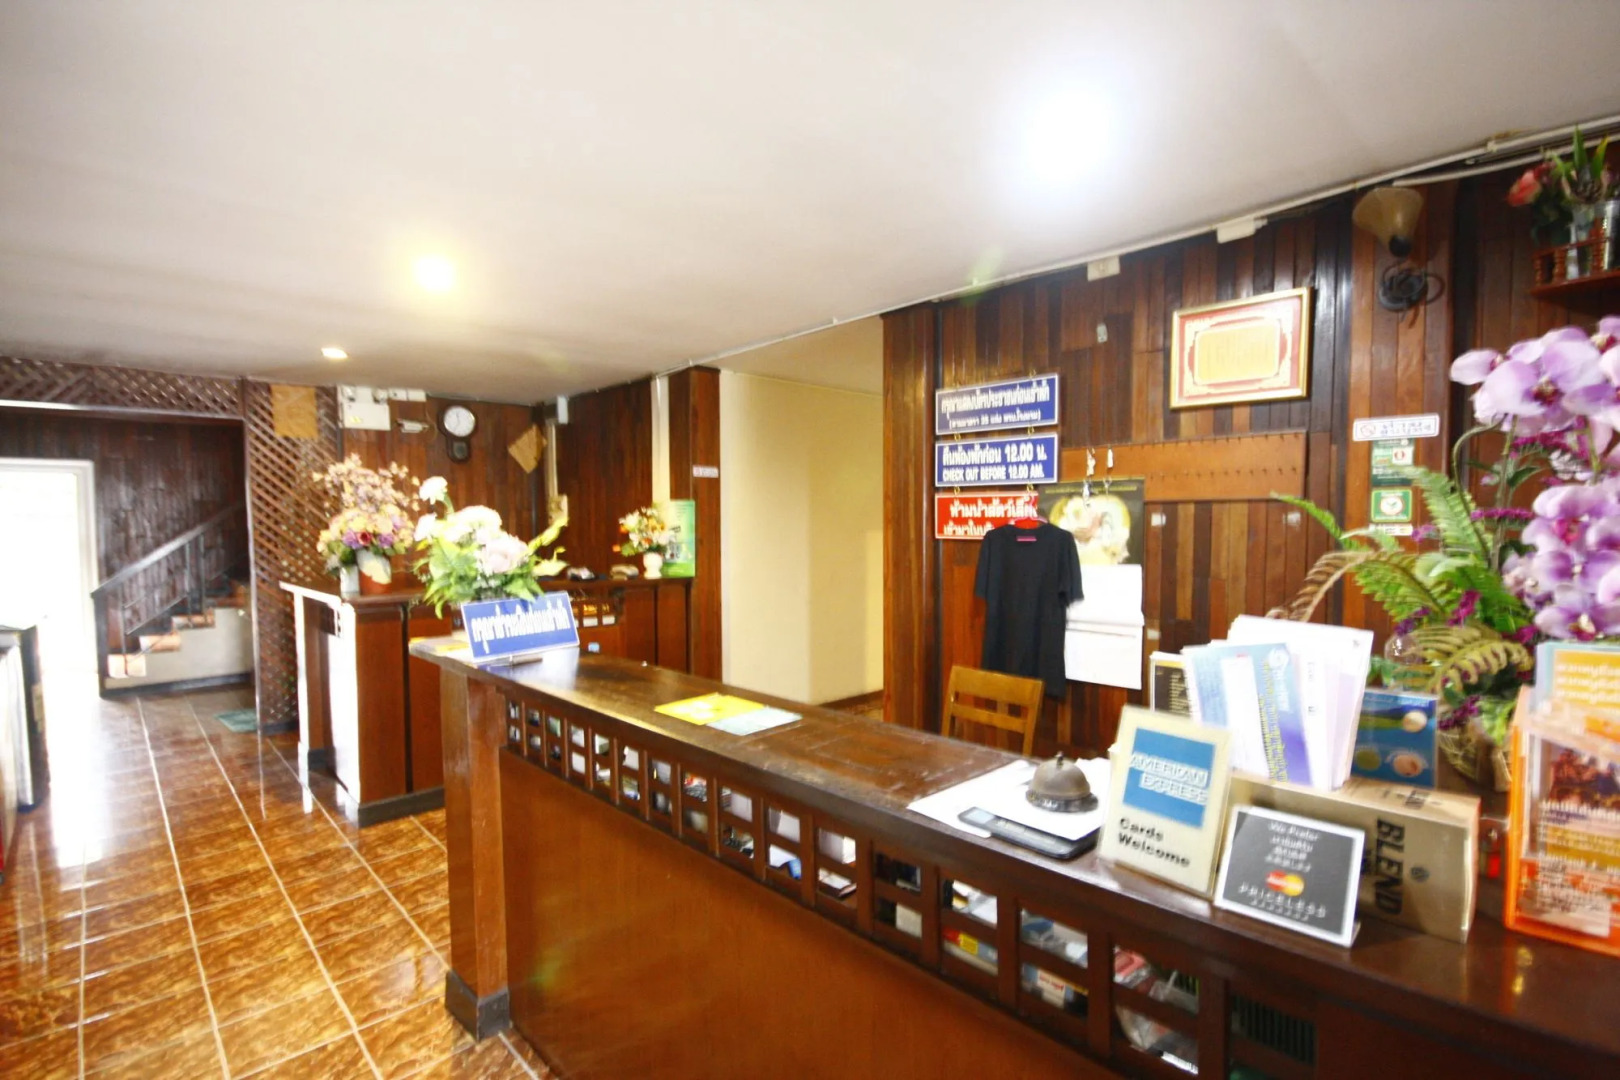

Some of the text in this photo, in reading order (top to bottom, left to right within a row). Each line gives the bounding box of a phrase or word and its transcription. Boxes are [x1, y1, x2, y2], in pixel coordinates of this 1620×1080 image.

[942, 442, 1047, 466] คืนห้องพักก่อน 12.00 น.
[943, 467, 964, 482] CHECK
[965, 466, 979, 481] OUT
[980, 465, 1006, 480] BEFORE
[1008, 464, 1028, 479] 12.00
[1130, 752, 1209, 787] AMERICAN
[1138, 773, 1209, 806] EXPRESS
[1119, 817, 1164, 841] Cards
[1118, 832, 1191, 868] Welcome
[1375, 817, 1406, 915] BLEND
